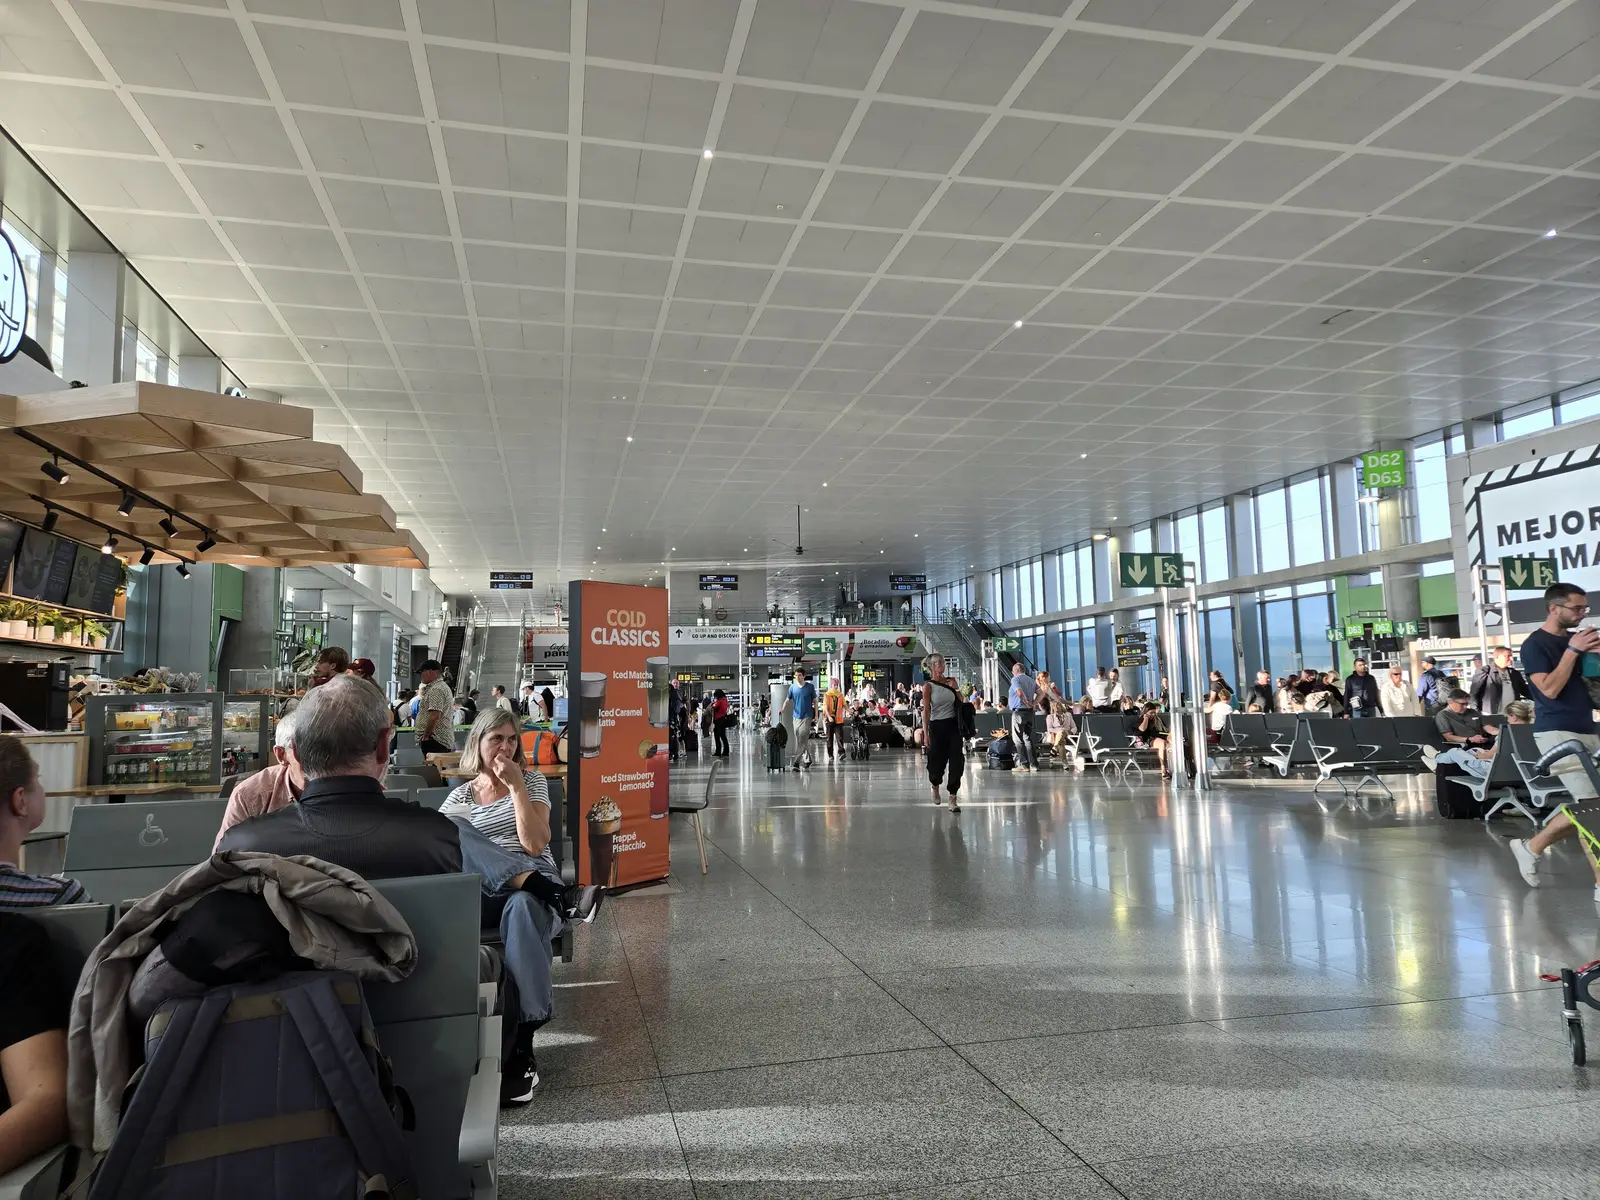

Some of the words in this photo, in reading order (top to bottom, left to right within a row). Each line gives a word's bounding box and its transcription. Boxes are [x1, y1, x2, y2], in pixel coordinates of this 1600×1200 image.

[1368, 453, 1400, 468] D62
[1369, 470, 1402, 485] D63
[606, 609, 647, 628] COLD
[1347, 625, 1362, 635] D63
[1375, 622, 1390, 632] D62
[591, 627, 661, 648] CLASSICS
[1417, 636, 1451, 650] teika
[613, 671, 628, 680] Iced
[628, 671, 653, 680] Matcha
[637, 680, 653, 689] Latte
[598, 708, 614, 718] Iced
[615, 707, 643, 717] Caramel
[598, 718, 616, 727] Latte
[601, 774, 617, 784] Iced
[617, 771, 655, 782] Strawberry
[619, 780, 655, 792] Lemonade
[612, 831, 637, 844] Frappé
[612, 840, 647, 854] Pistacchio
